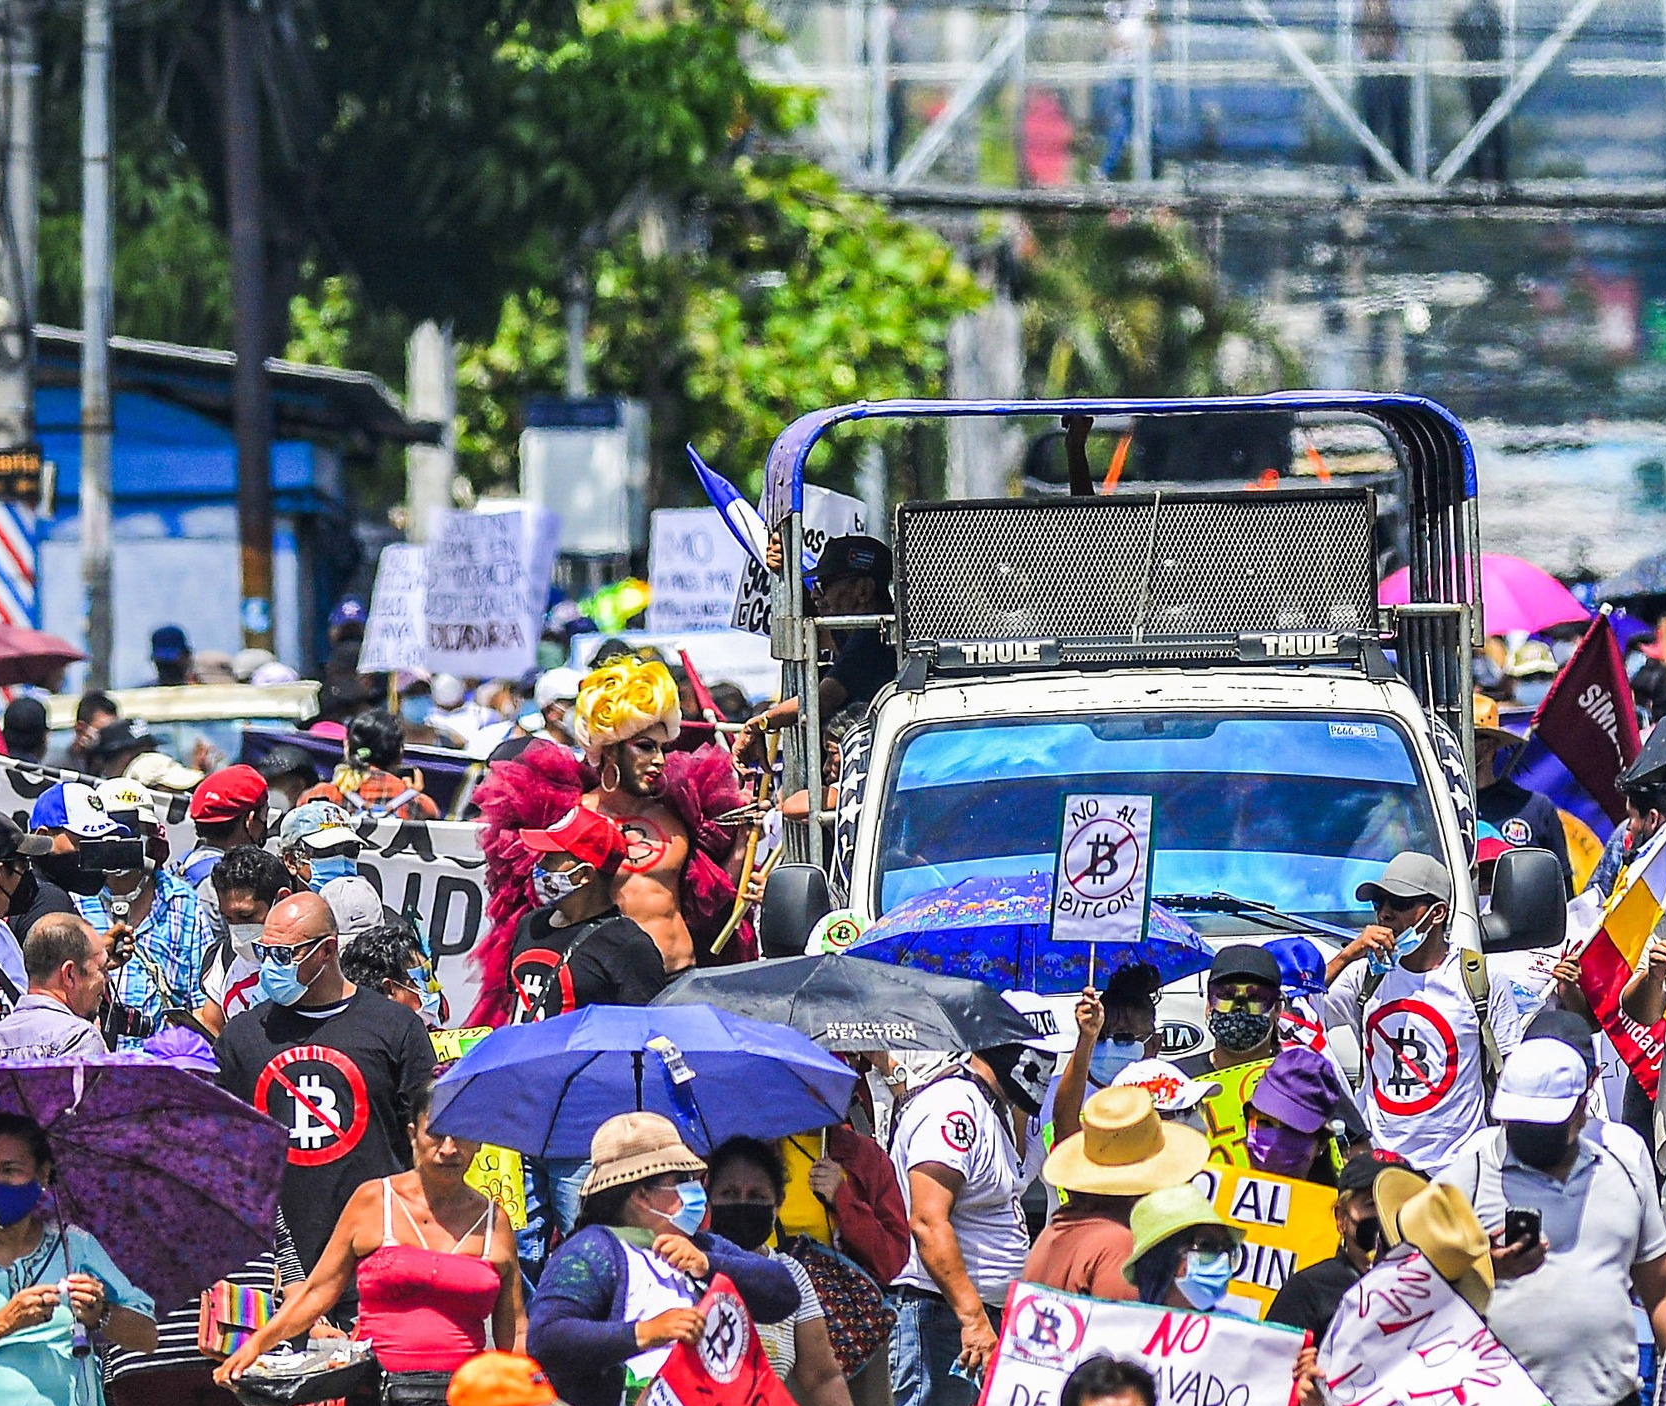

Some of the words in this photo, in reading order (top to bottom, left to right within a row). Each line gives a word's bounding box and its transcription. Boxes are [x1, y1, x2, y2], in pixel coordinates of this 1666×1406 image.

[961, 644, 1041, 664] THULE
[1261, 634, 1340, 656] THULE
[1072, 799, 1099, 828] NO
[1117, 804, 1136, 828] AL
[1057, 886, 1135, 919] BITCON
[826, 1021, 879, 1030] KENNETH
[883, 1021, 915, 1031] COLE
[826, 1028, 917, 1040] REACTION
[1157, 1027, 1193, 1048] IA
[1231, 1180, 1287, 1224] AL
[1142, 1311, 1211, 1358] NO
